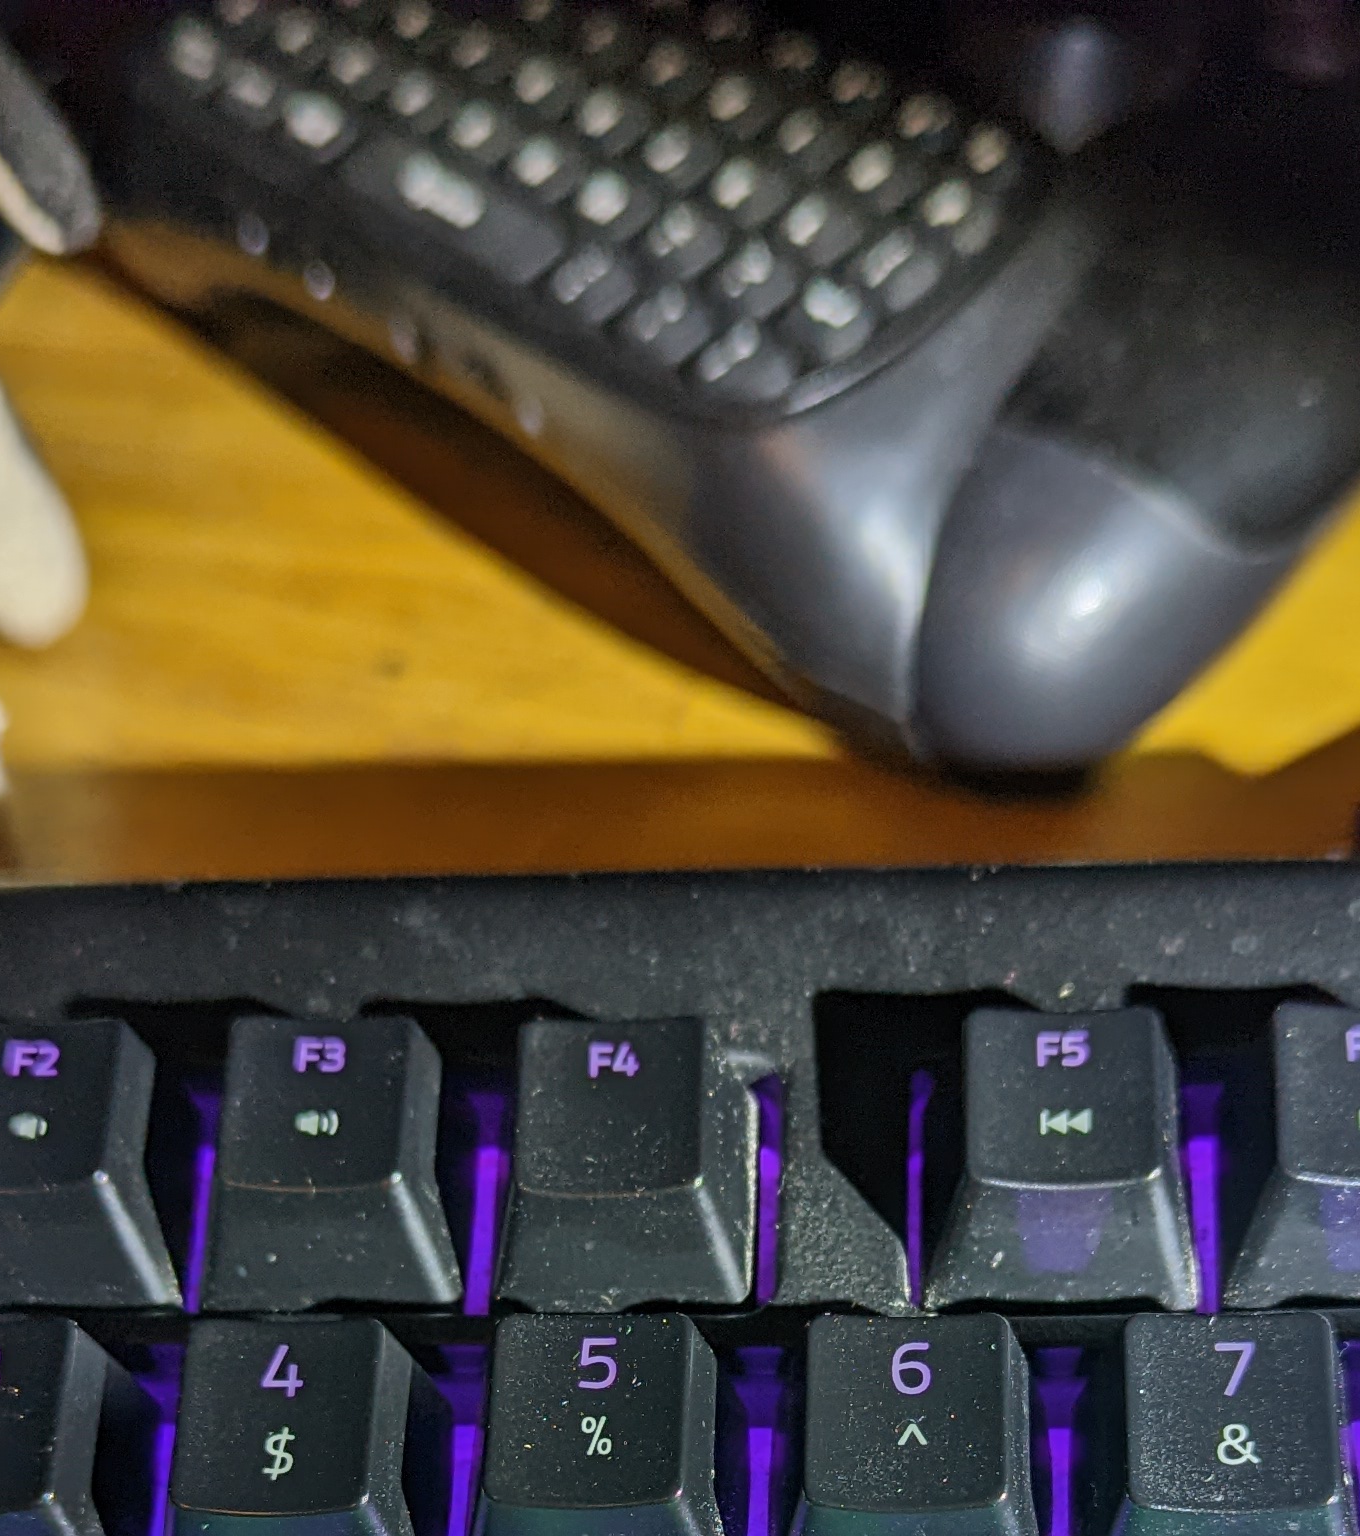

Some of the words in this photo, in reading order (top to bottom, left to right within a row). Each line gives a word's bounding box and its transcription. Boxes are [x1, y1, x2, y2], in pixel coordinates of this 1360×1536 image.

[2, 1039, 60, 1080] F2
[292, 1036, 345, 1074] F3
[587, 1042, 639, 1078] F4
[1036, 1030, 1091, 1066] F5
[260, 1344, 304, 1398] 4
[577, 1336, 617, 1390] 5
[891, 1341, 932, 1395] 6
[1214, 1341, 1255, 1397] 7
[264, 1426, 294, 1480] $
[580, 1415, 613, 1457] %
[1216, 1423, 1262, 1465] &
